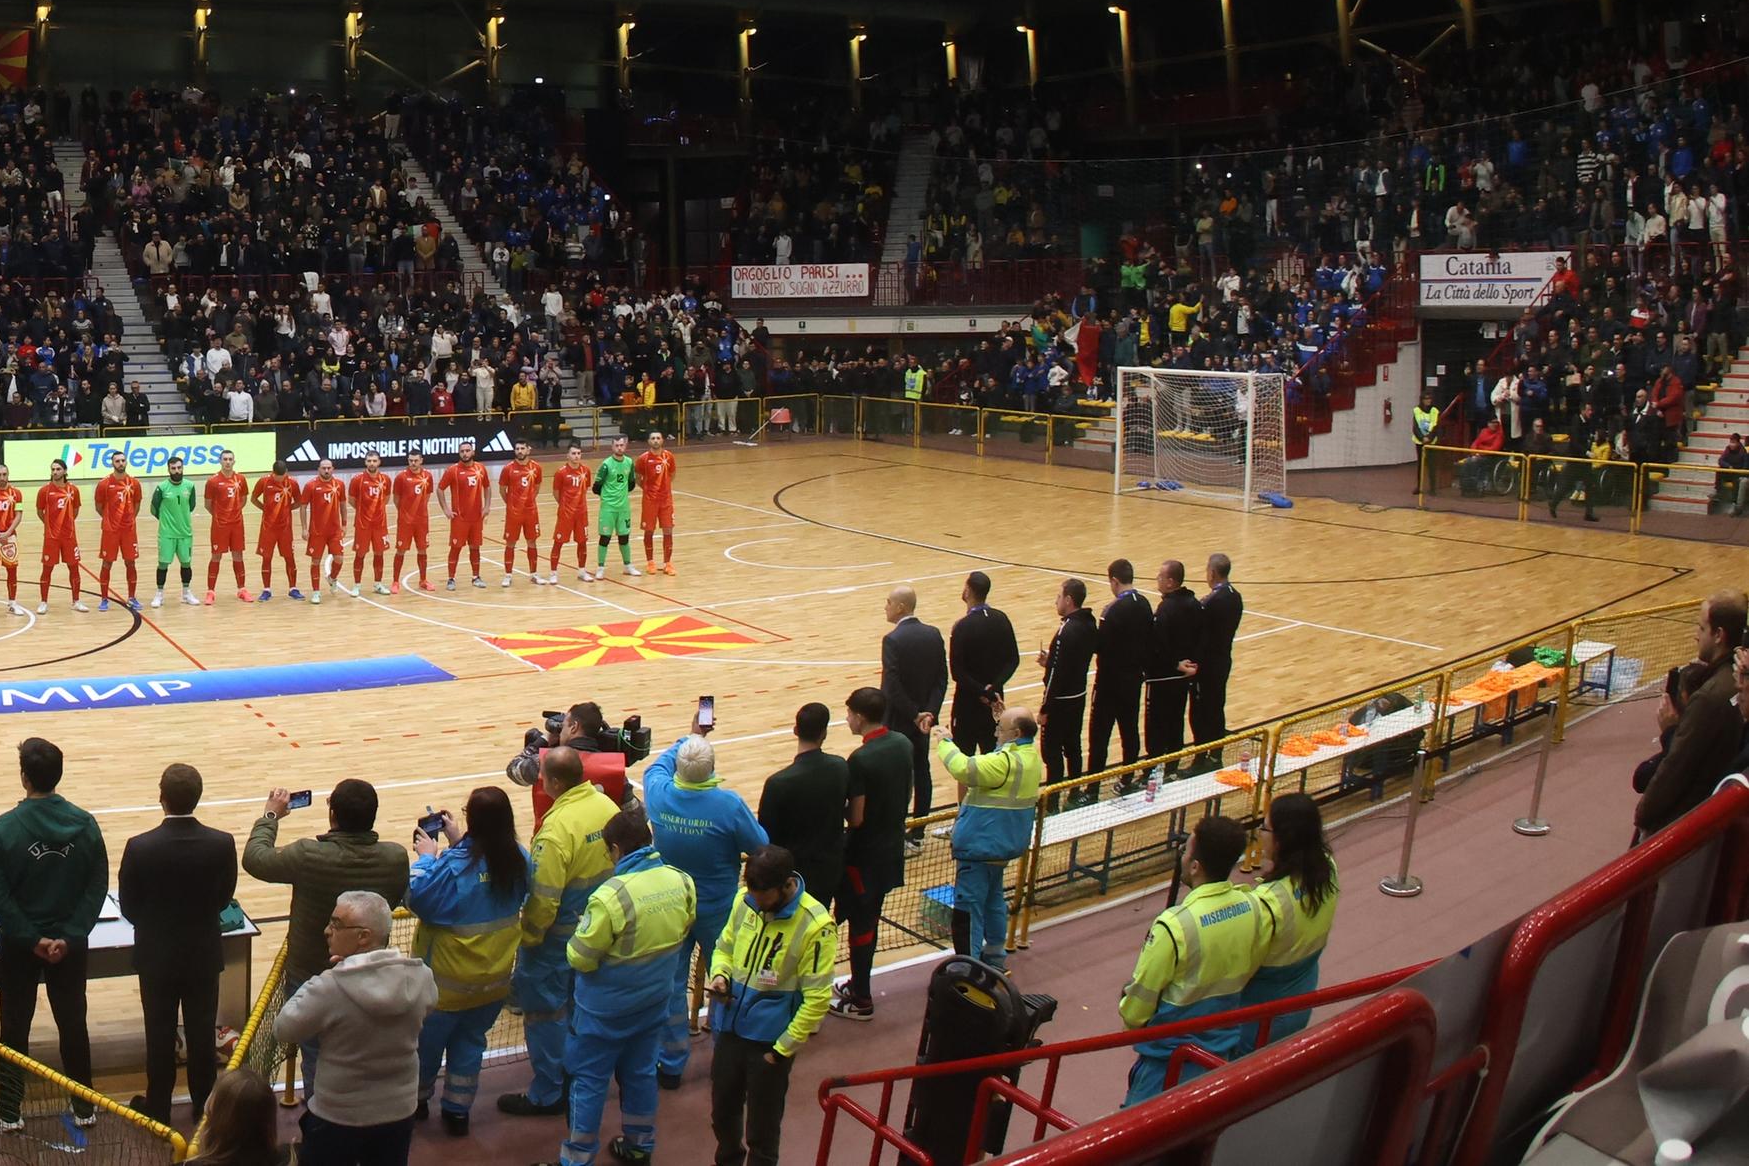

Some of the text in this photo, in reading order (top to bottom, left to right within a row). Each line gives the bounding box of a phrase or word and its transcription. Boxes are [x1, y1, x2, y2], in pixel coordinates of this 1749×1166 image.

[1445, 256, 1512, 276] Catania
[734, 266, 792, 281] ORGOGLIO
[801, 265, 839, 279] PARISI
[751, 282, 786, 296] NOSTRO
[789, 281, 819, 295] SOGNO
[822, 279, 864, 295] AZZURRO
[1425, 283, 1534, 304] La Città dello Sport
[328, 440, 407, 459] IMPOSSIBILE
[408, 439, 421, 452] IS
[88, 440, 224, 473] Telepass
[655, 464, 661, 474] 9
[467, 476, 477, 486] 15
[521, 478, 528, 487] 5
[572, 477, 579, 487] 11
[616, 473, 624, 483] 12
[227, 487, 236, 498] 3
[414, 485, 421, 494] 6
[176, 495, 181, 505] 1
[274, 493, 281, 503] 8
[323, 493, 332, 503] 4
[0, 501, 10, 511] 10
[58, 499, 65, 509] 2
[1, 679, 194, 708] МИР
